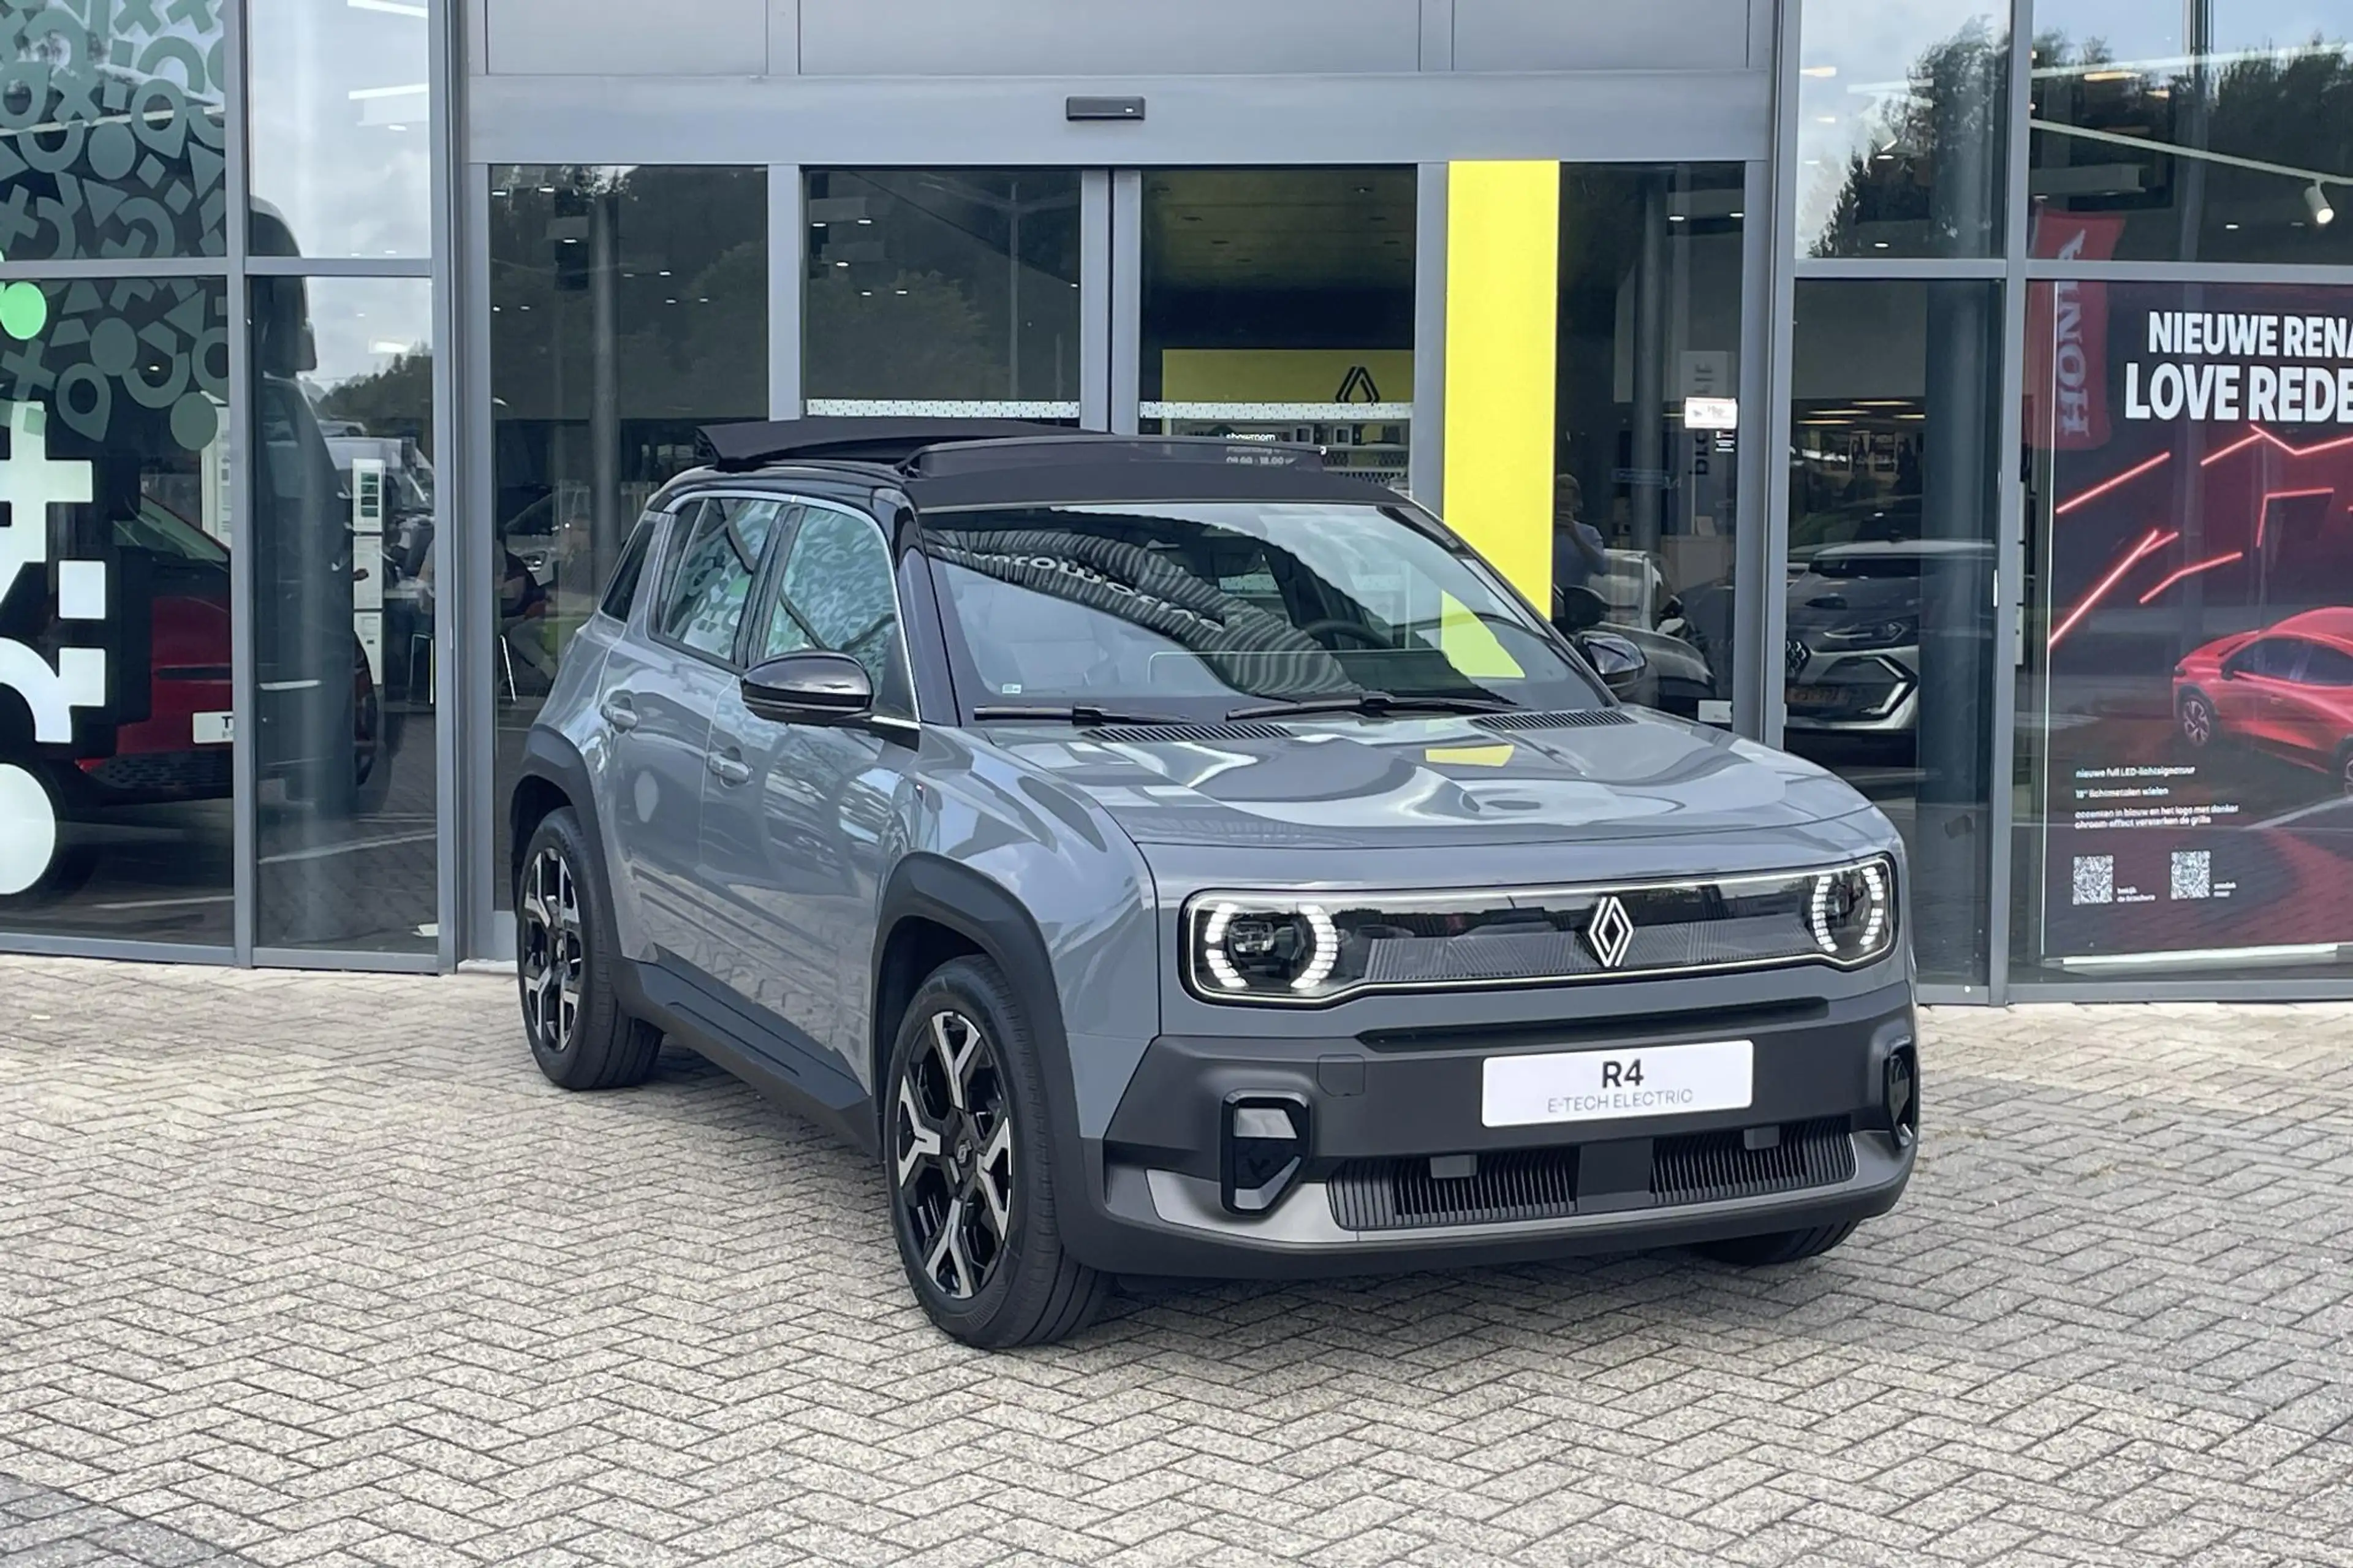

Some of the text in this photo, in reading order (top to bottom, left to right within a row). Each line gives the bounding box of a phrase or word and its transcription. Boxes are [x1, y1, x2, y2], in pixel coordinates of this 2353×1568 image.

[2056, 229, 2090, 437] HONA
[2149, 311, 2278, 357] NIEUWE
[2125, 362, 2240, 420] LOVE
[1602, 1059, 1644, 1088] R4
[1548, 1089, 1693, 1113] E-TECH ELECTRIC
